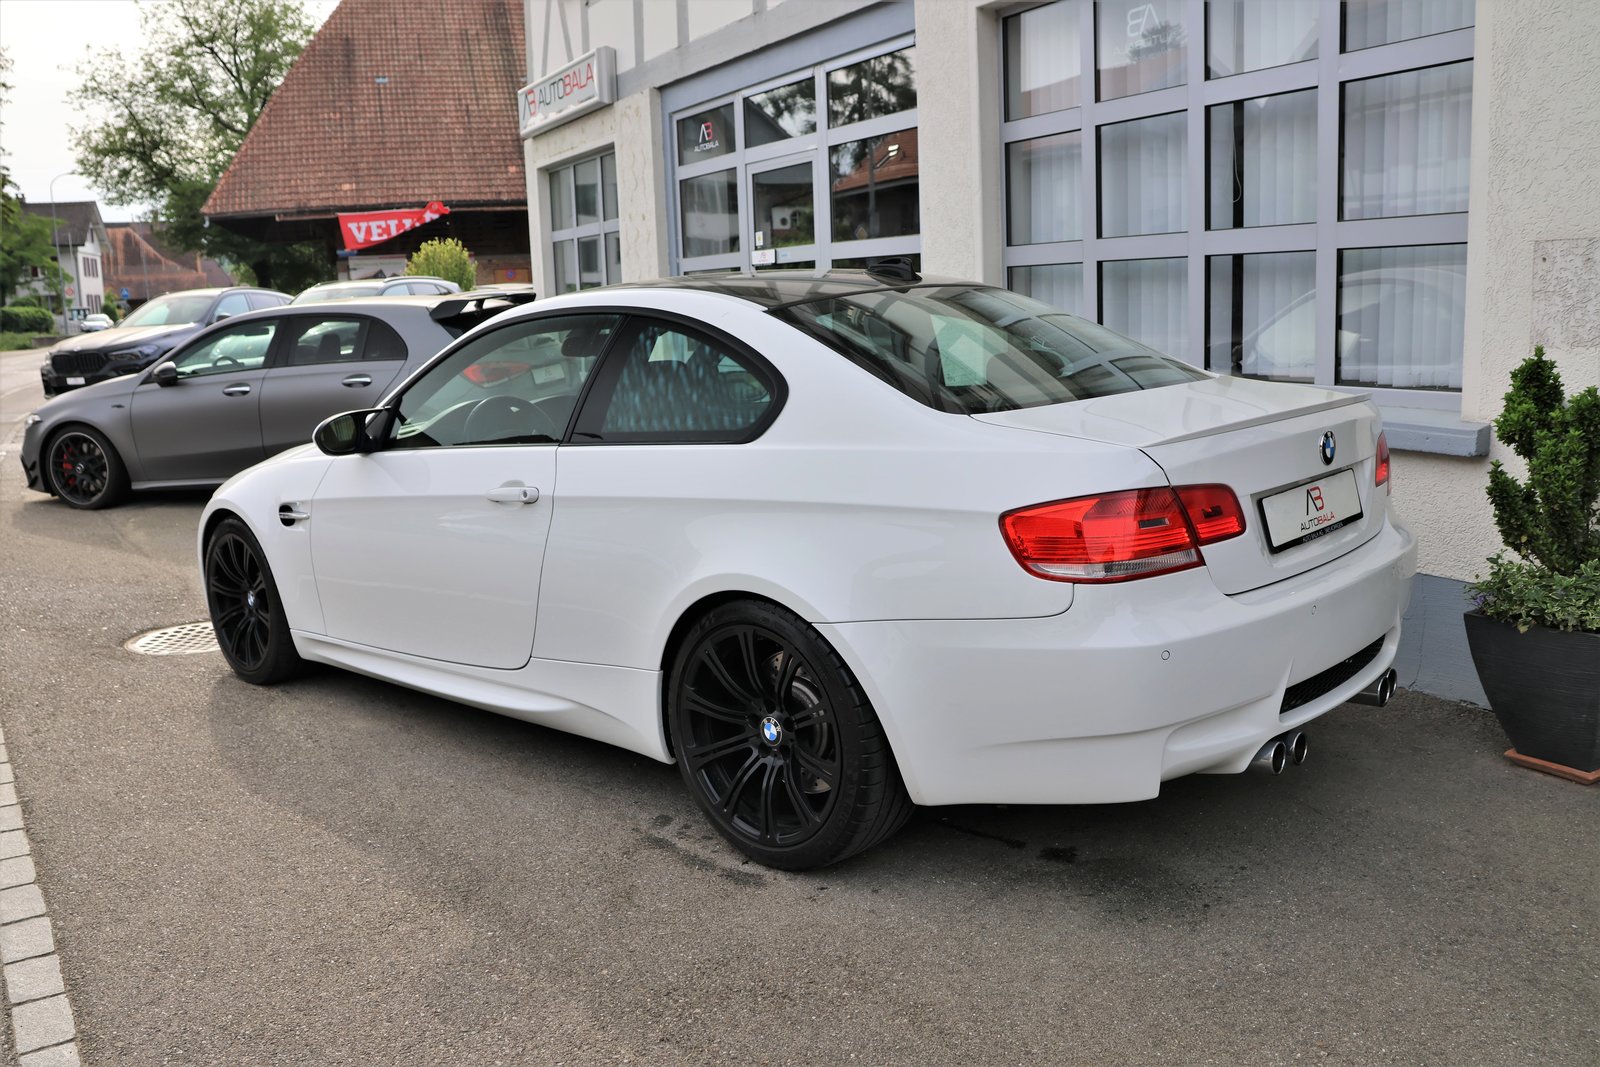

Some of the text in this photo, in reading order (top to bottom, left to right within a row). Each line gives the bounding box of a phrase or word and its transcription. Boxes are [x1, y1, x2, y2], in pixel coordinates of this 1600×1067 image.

[538, 63, 594, 107] AUTOBALA
[1306, 486, 1324, 516] AB
[1300, 511, 1336, 532] AUTOBALA
